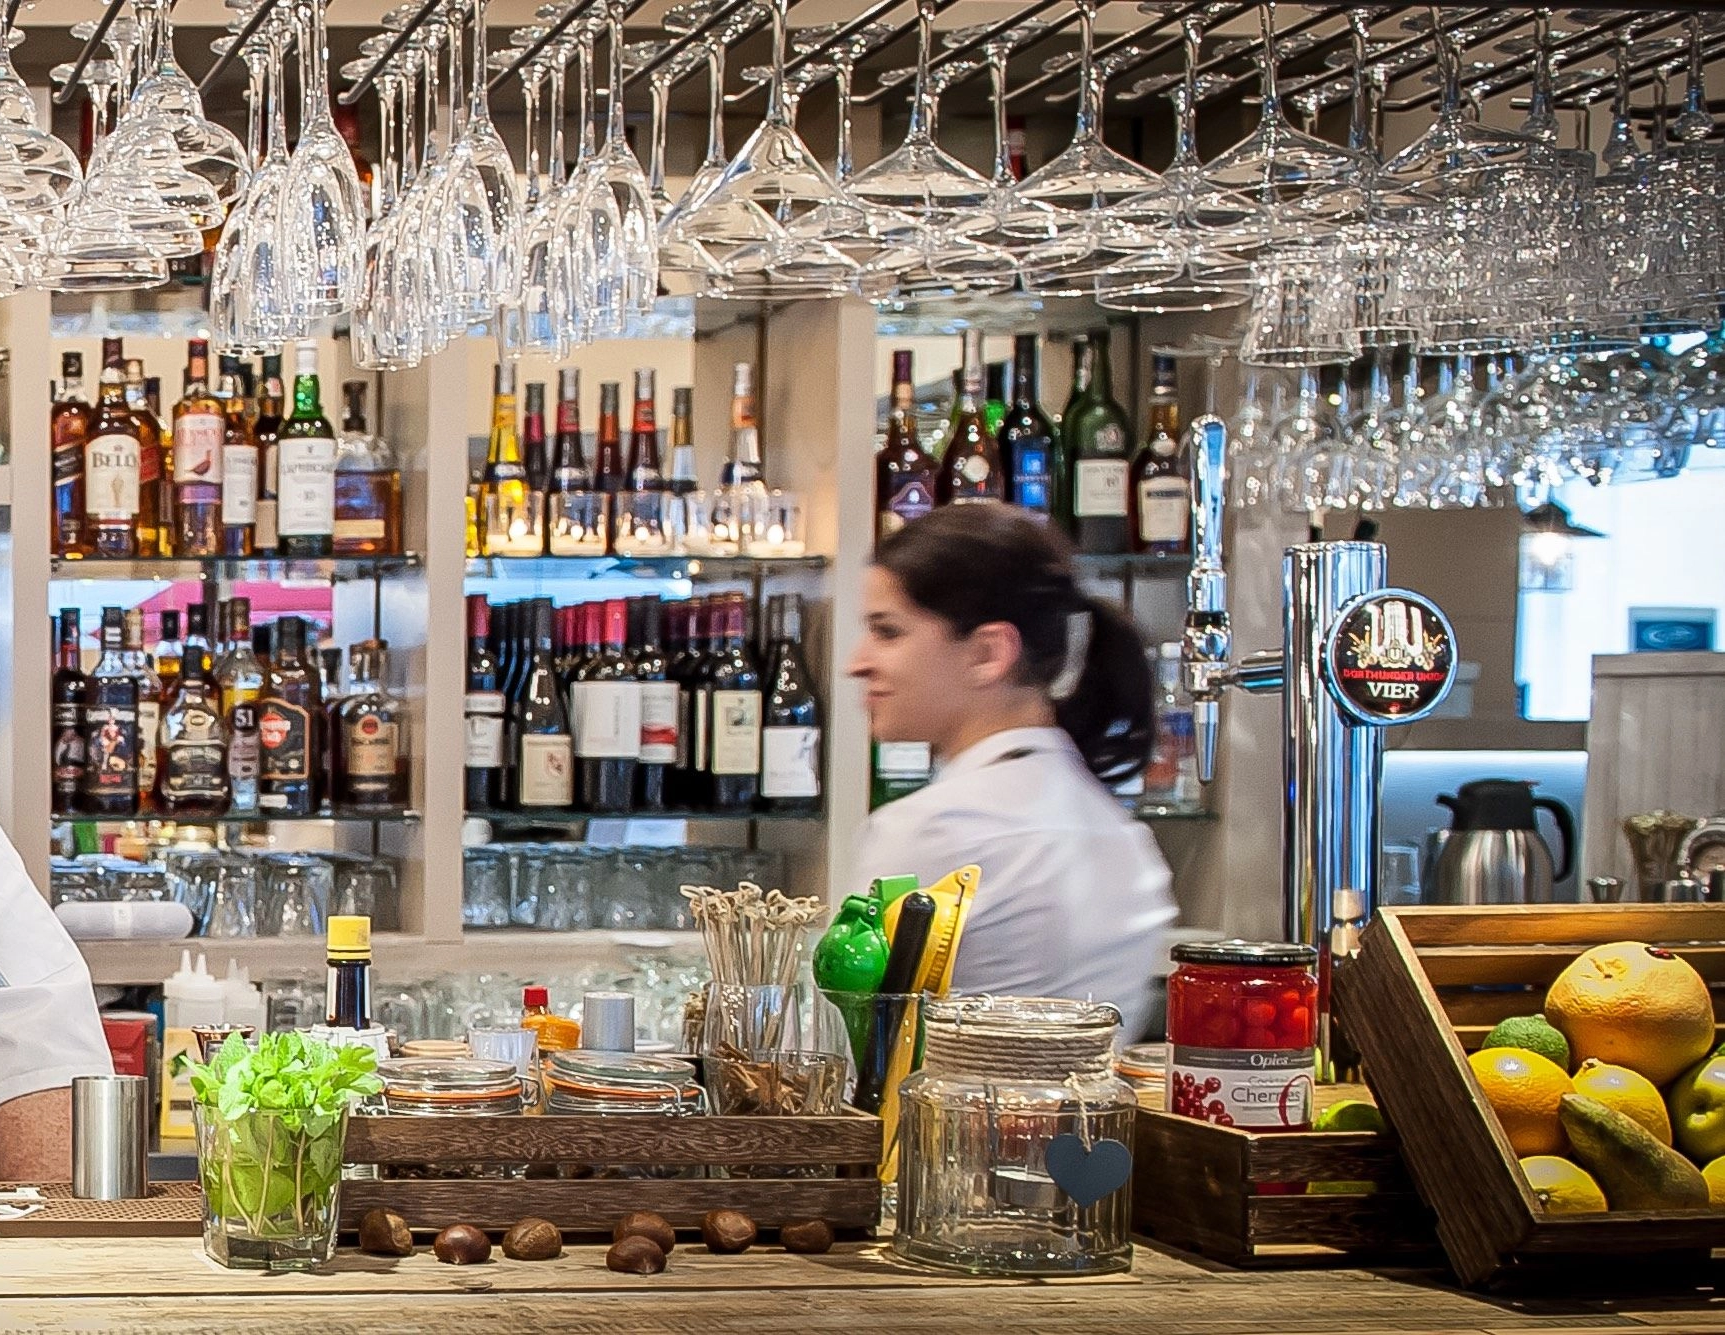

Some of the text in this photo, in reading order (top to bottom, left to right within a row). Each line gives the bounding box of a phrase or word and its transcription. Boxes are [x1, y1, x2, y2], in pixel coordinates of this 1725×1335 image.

[1366, 681, 1420, 699] VIER
[235, 708, 254, 728] 51
[1250, 1053, 1289, 1069] Opies
[1231, 1087, 1301, 1103] Cherres
